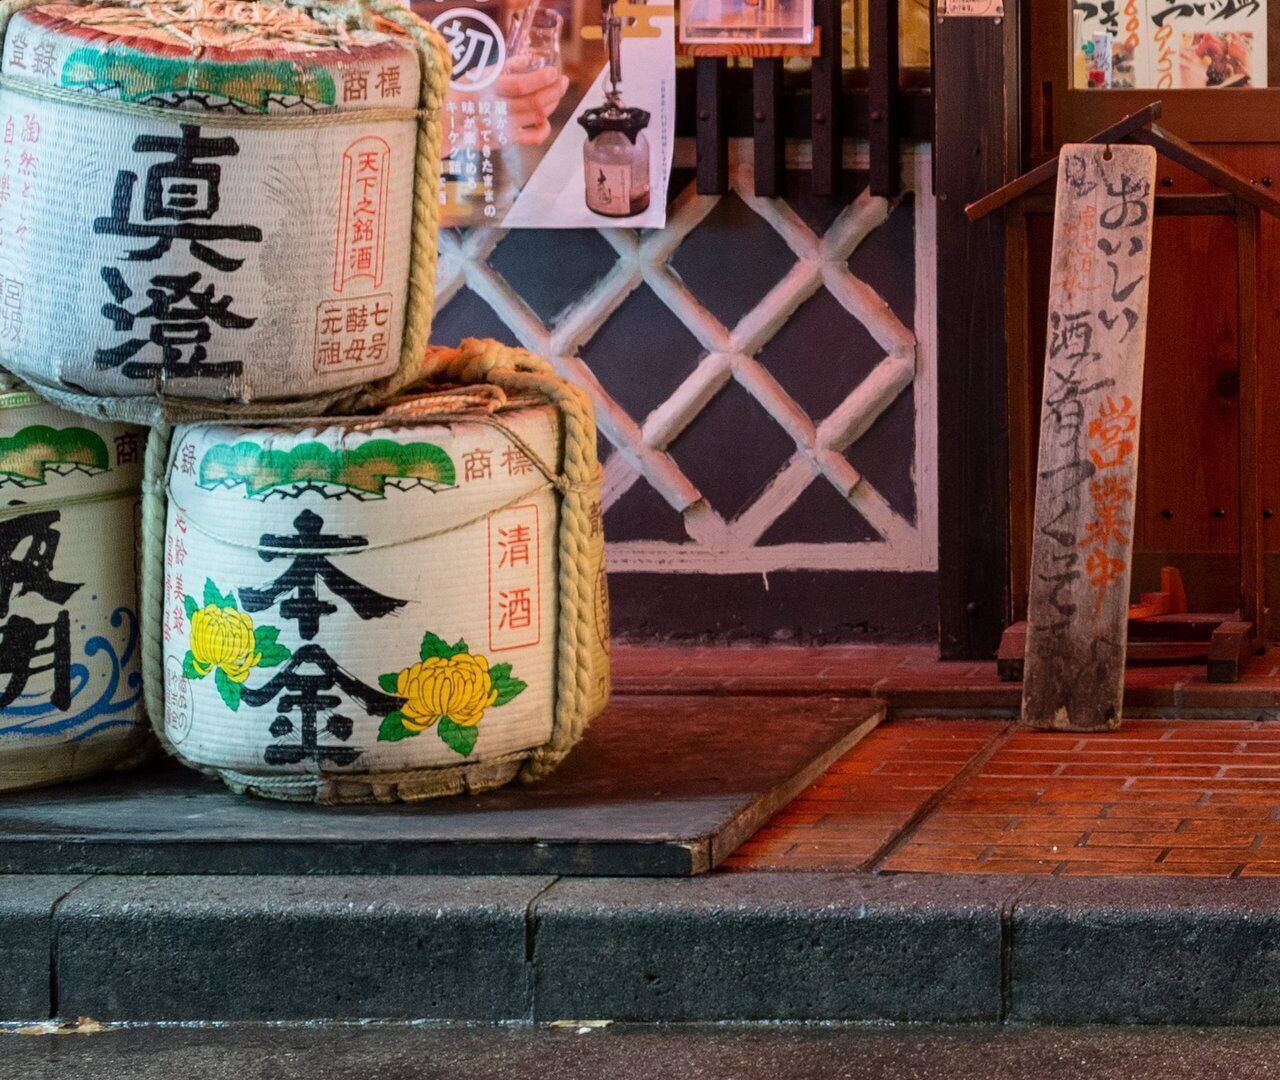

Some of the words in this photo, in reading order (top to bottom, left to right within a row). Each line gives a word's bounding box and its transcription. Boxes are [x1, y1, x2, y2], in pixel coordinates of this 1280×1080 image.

[342, 64, 403, 103] 商標
[349, 151, 380, 272] 天下之銘酒
[460, 442, 537, 483] 商標
[497, 524, 534, 632] 清酒
[236, 508, 420, 766] 本金
